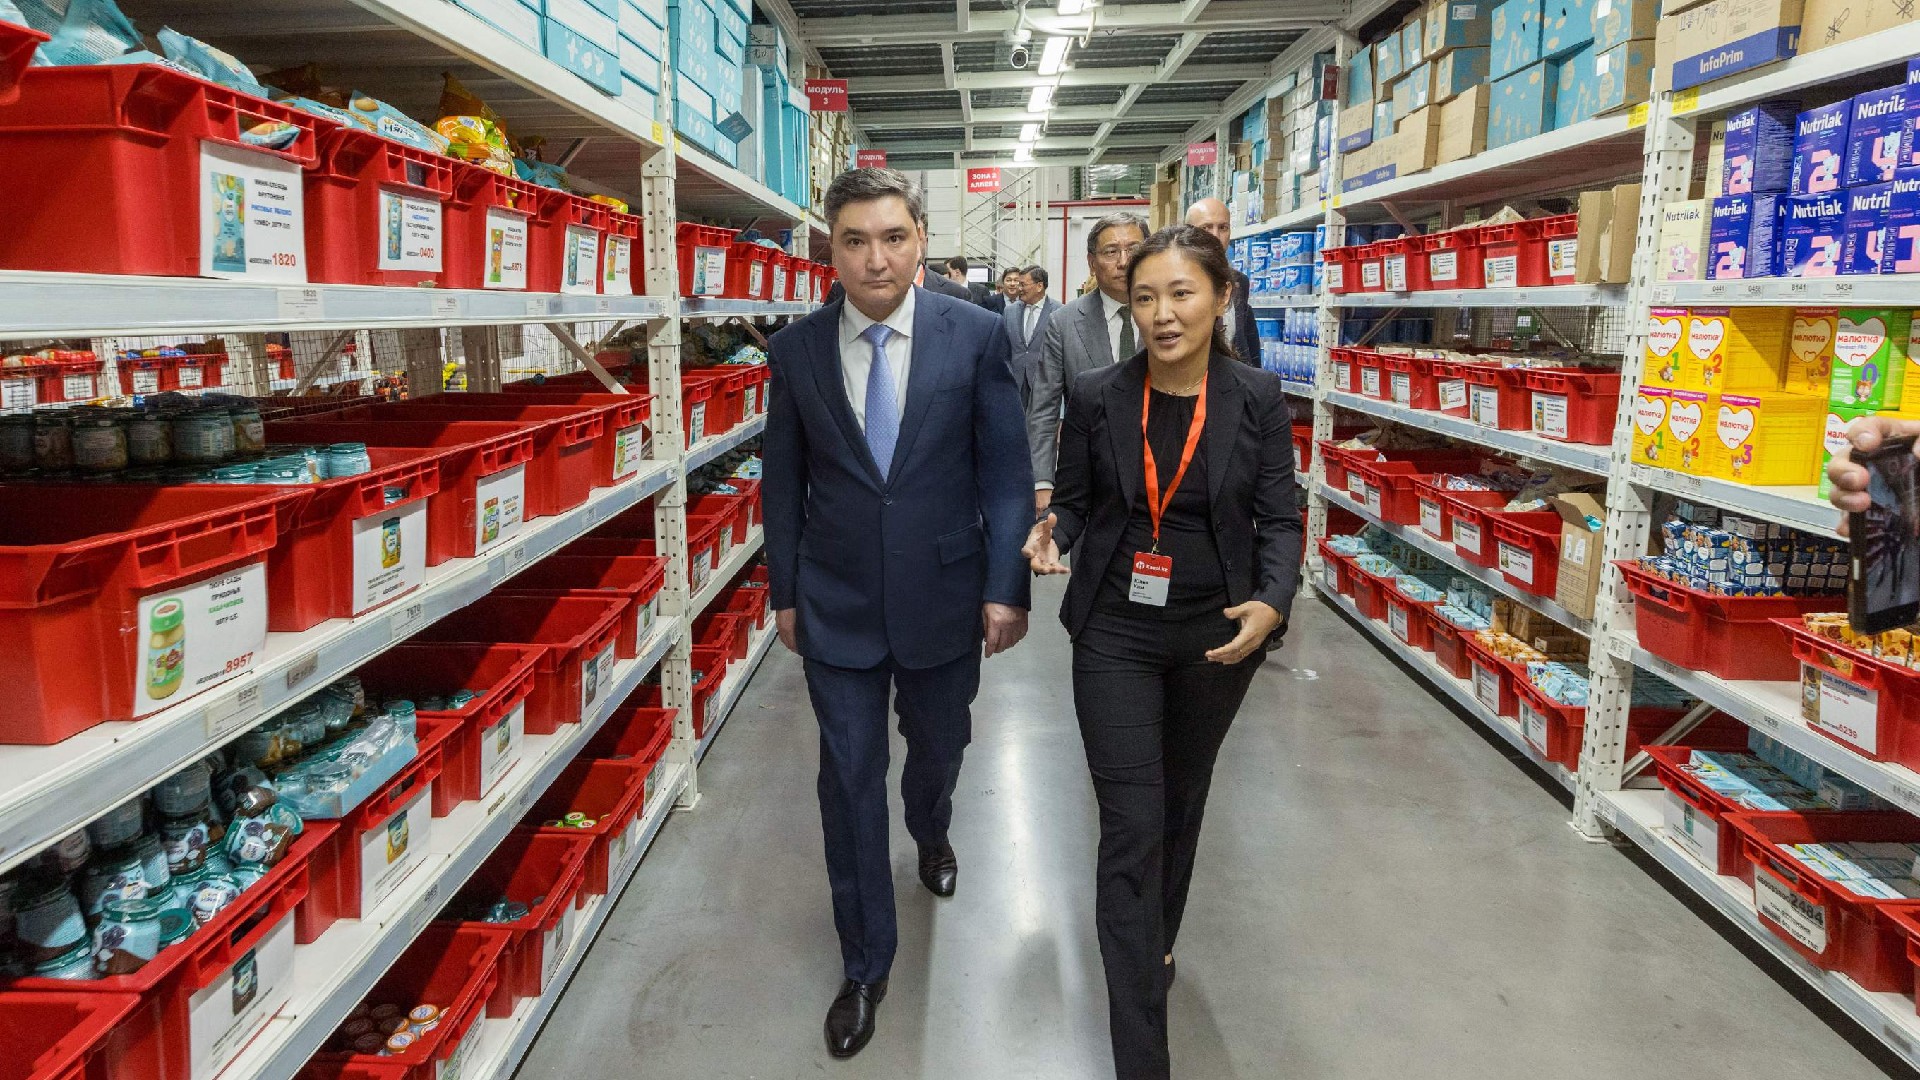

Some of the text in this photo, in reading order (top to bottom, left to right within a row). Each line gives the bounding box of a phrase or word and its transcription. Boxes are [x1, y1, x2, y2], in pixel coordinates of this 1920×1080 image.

[1700, 50, 1744, 74] InfaPrim
[808, 86, 845, 95] МОДУЛЬ
[823, 97, 829, 105] 3
[1727, 114, 1755, 133] Nutrilak
[1799, 111, 1843, 136] Nutrilak
[1666, 208, 1700, 222] Nutrilak
[1713, 202, 1747, 218] Nutrilak
[1793, 199, 1843, 219] Nutrilak
[272, 252, 296, 267] 1820
[1692, 333, 1719, 341] малютка
[1794, 334, 1825, 343] малютка
[1837, 335, 1879, 344] малютка
[1671, 351, 1680, 371] 1
[1712, 353, 1722, 374] 2
[1818, 356, 1830, 377] 3
[1638, 409, 1662, 419] малютка
[1672, 415, 1697, 425] малютка
[1720, 420, 1749, 431] малютка
[1656, 431, 1664, 449] 1
[1691, 438, 1700, 458] 2
[1742, 444, 1753, 465] 3
[225, 651, 254, 674] 8957
[238, 684, 258, 702] 8957
[1789, 892, 1824, 926] 2484
